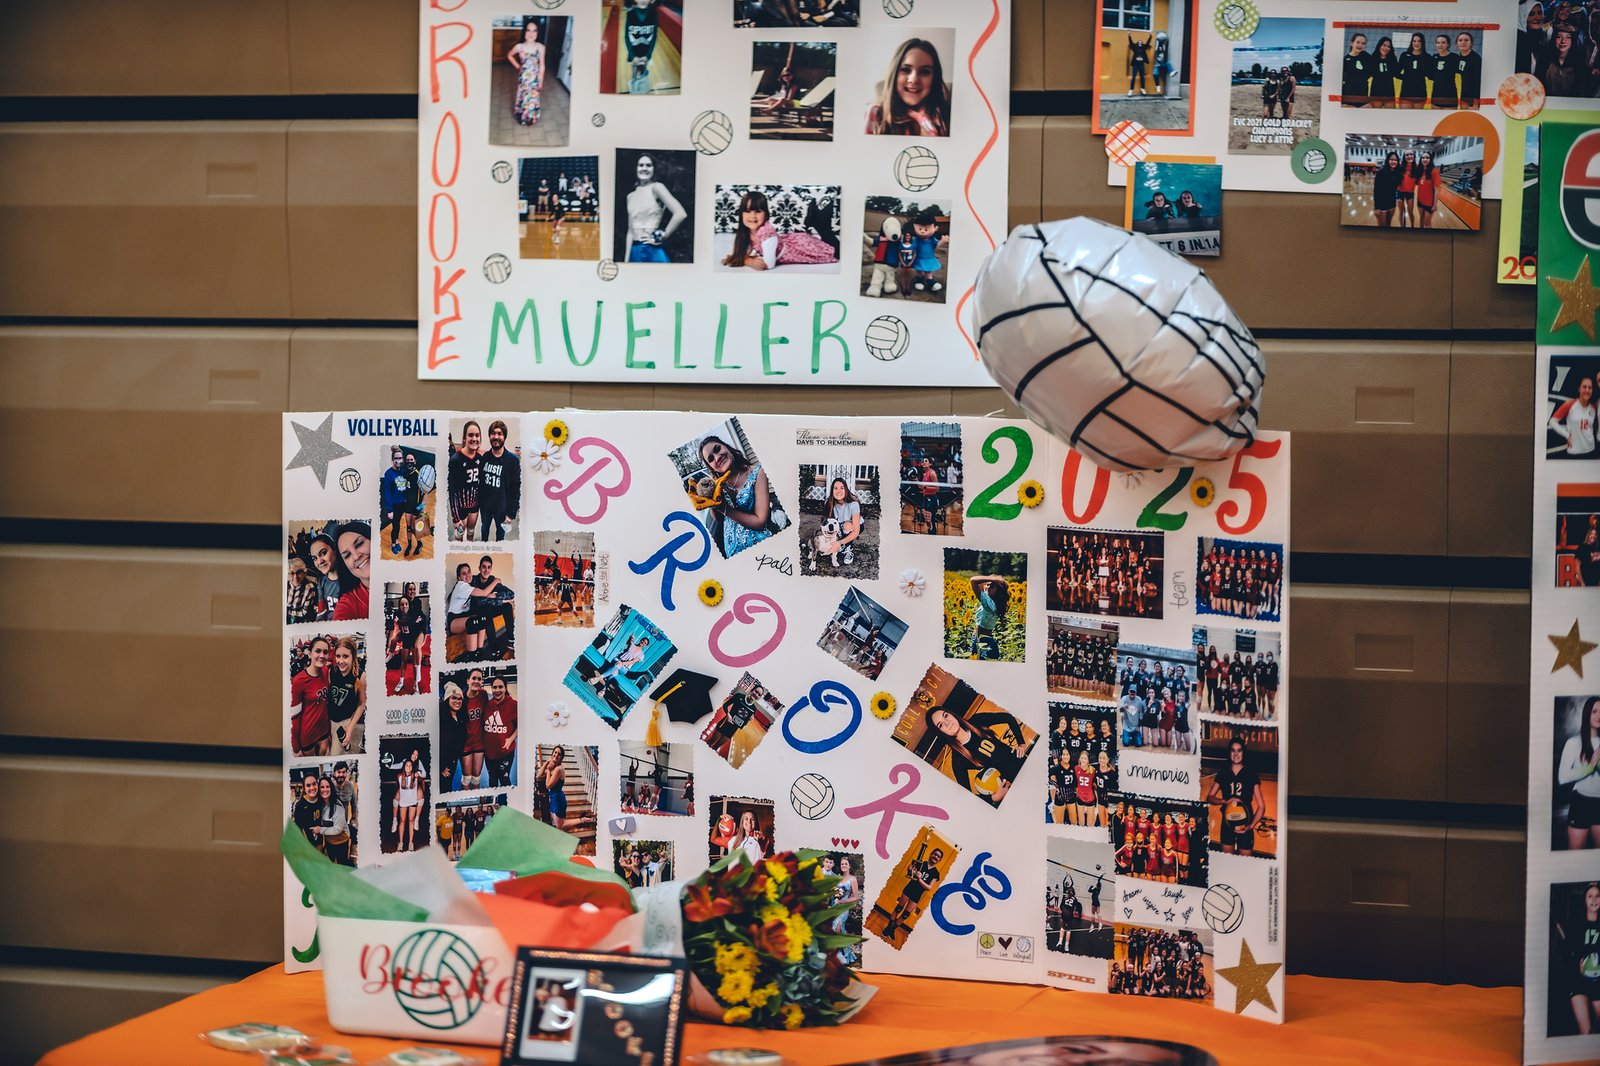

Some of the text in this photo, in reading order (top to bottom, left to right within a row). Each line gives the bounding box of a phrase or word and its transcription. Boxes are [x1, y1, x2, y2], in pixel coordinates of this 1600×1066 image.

[1246, 118, 1263, 127] 2021
[1263, 118, 1281, 127] GOLD
[1250, 135, 1267, 144] LUCY
[427, 0, 474, 370] ROOKE
[1177, 240, 1186, 251] 6
[486, 298, 851, 376] MUELLER
[347, 418, 439, 437] VOLLEYBALL
[839, 432, 852, 440] the
[466, 468, 479, 483] 32
[485, 473, 501, 488] 3:16
[331, 685, 349, 706] 27
[386, 709, 402, 720] GOOD
[410, 708, 426, 719] GOOD
[468, 708, 481, 721] 28
[896, 707, 921, 736] COAL
[484, 723, 508, 734] adidas
[1213, 728, 1274, 743] COAL CITY
[978, 739, 996, 757] 10
[1071, 739, 1080, 748] 20
[1086, 742, 1092, 751] 3
[1079, 776, 1090, 787] 52
[1127, 764, 1190, 785] memories
[1230, 781, 1243, 796] 12
[1161, 887, 1186, 904] laugh
[1047, 970, 1096, 985] SPIKE
